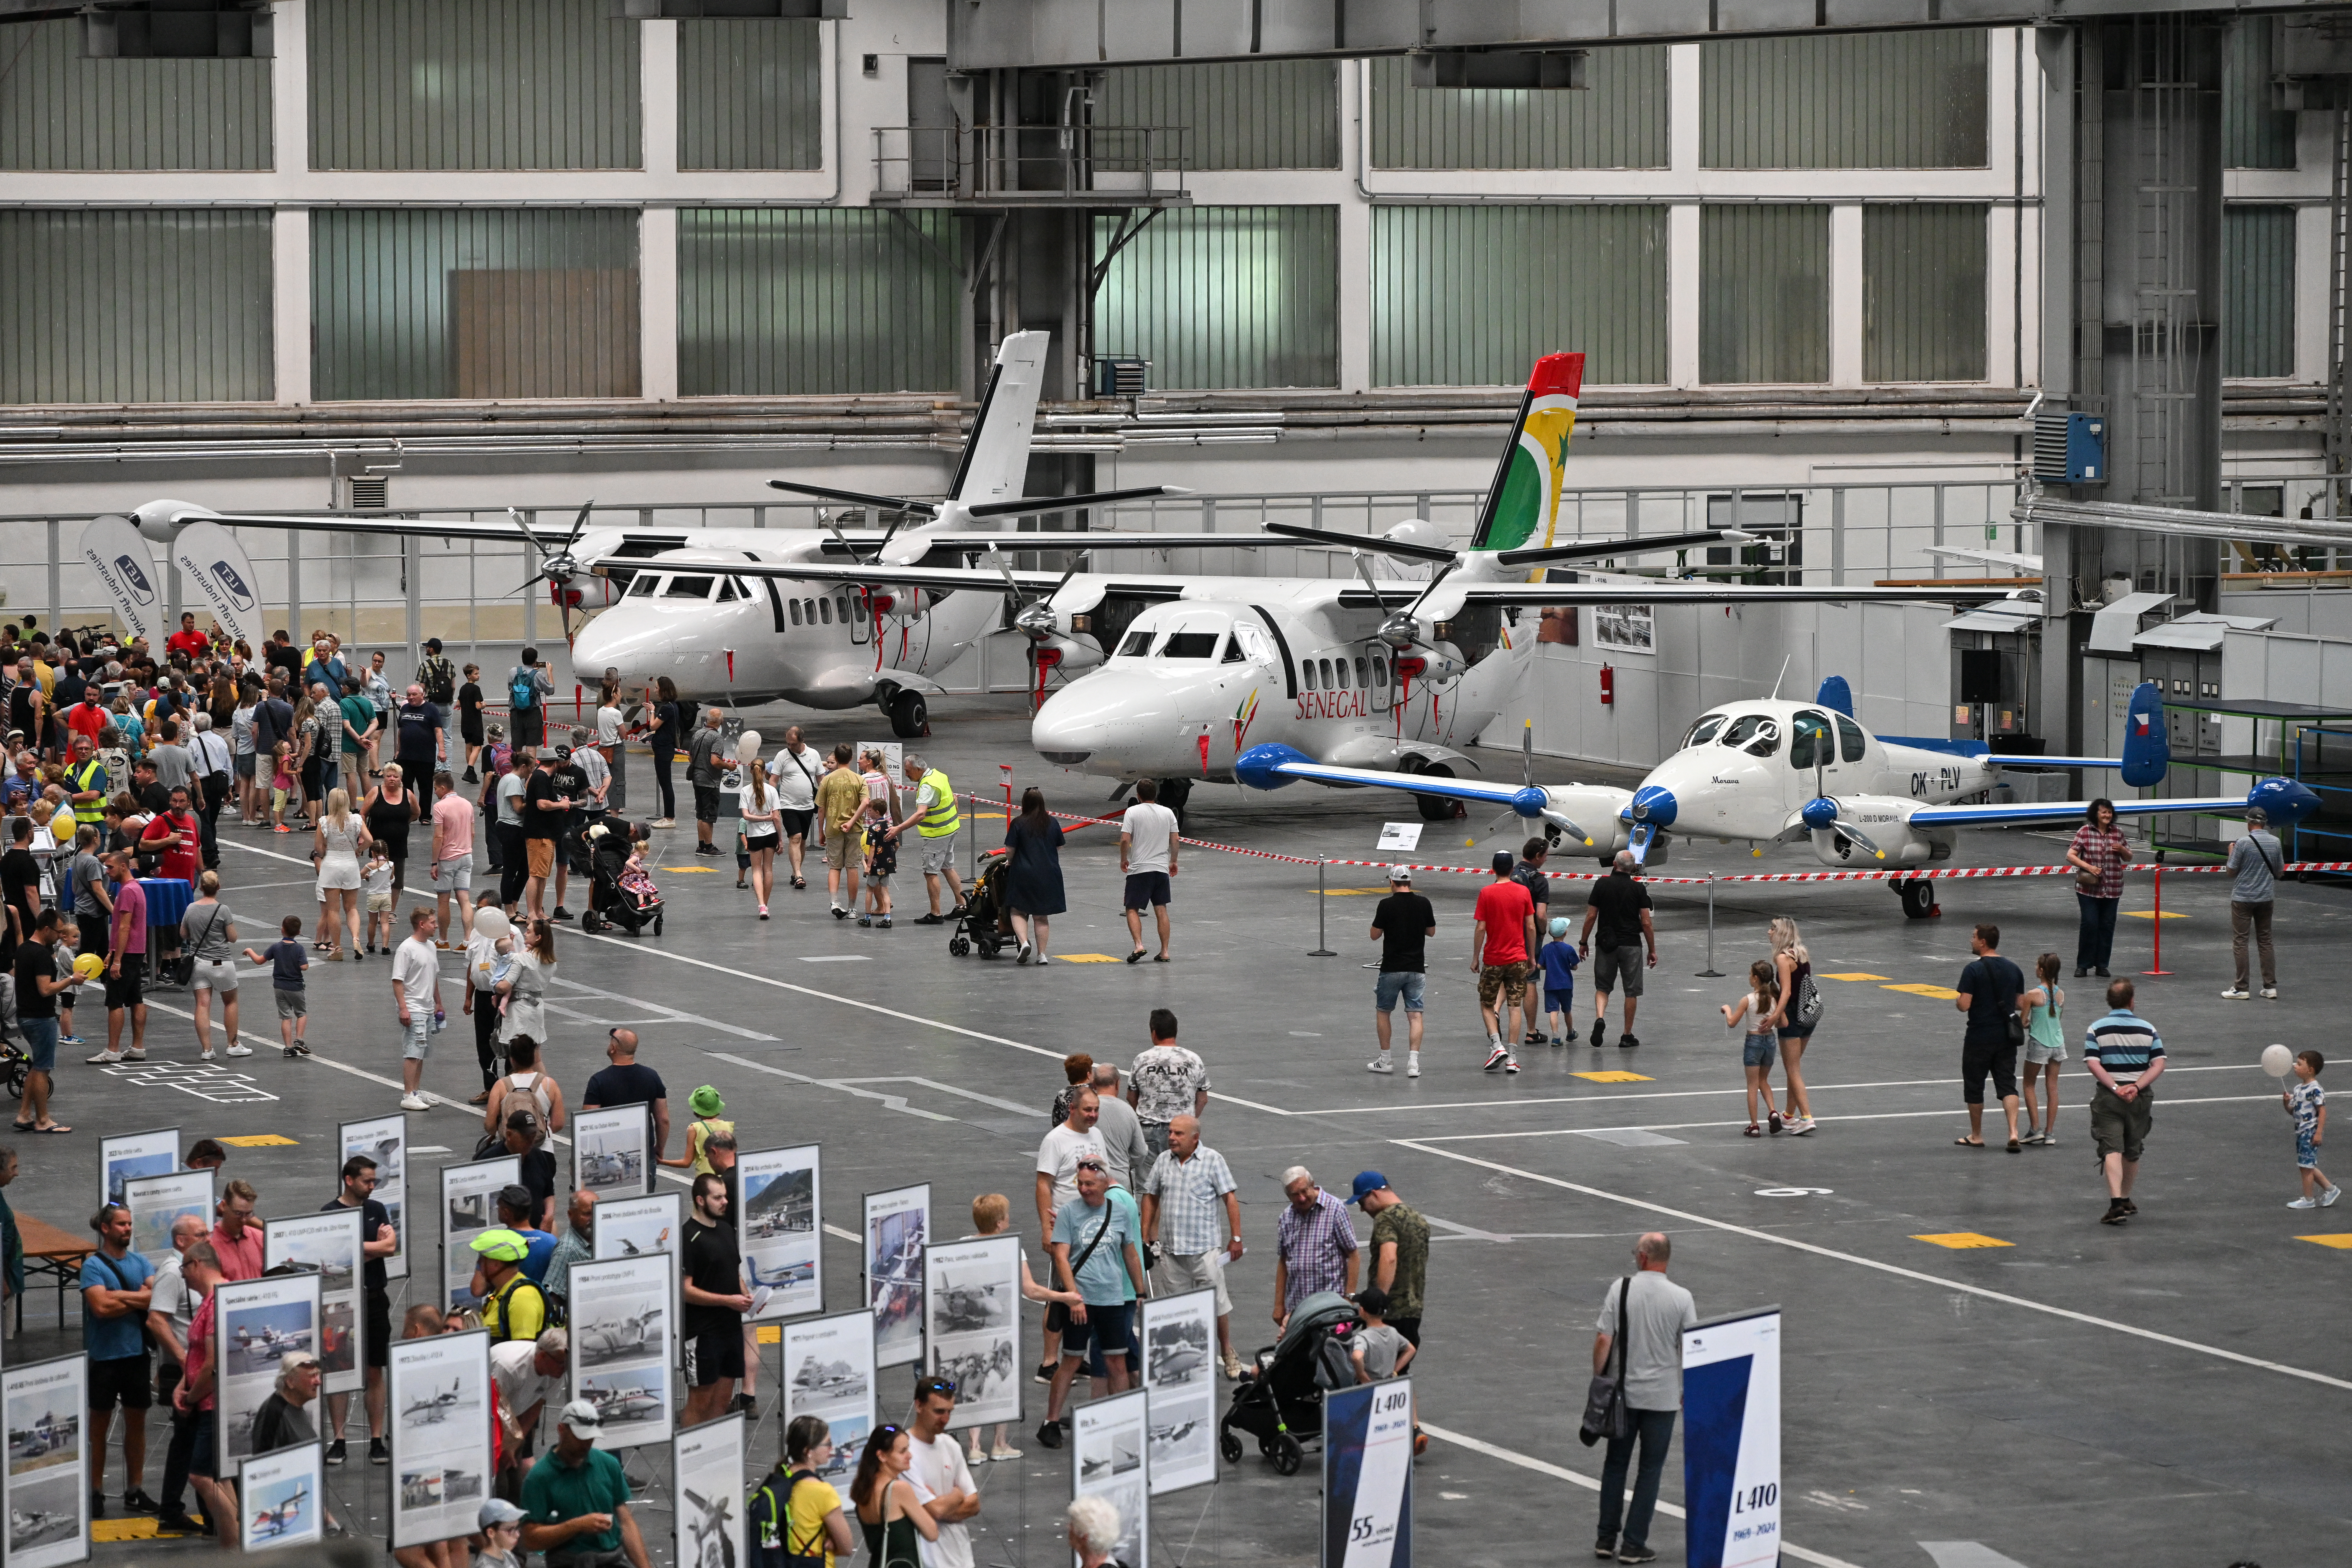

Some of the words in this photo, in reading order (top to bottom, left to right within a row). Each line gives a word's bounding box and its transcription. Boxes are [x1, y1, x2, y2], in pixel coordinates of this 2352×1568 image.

[1296, 690, 1367, 720] SENEGAL
[553, 773, 575, 785] FLAMES
[1912, 772, 1927, 797] OK
[1941, 766, 1960, 792] PLV
[1147, 1066, 1188, 1076] PALM
[1374, 1398, 1381, 1415] L
[1384, 1392, 1406, 1412] 410
[1735, 1490, 1744, 1515] L
[1747, 1483, 1777, 1511] 410
